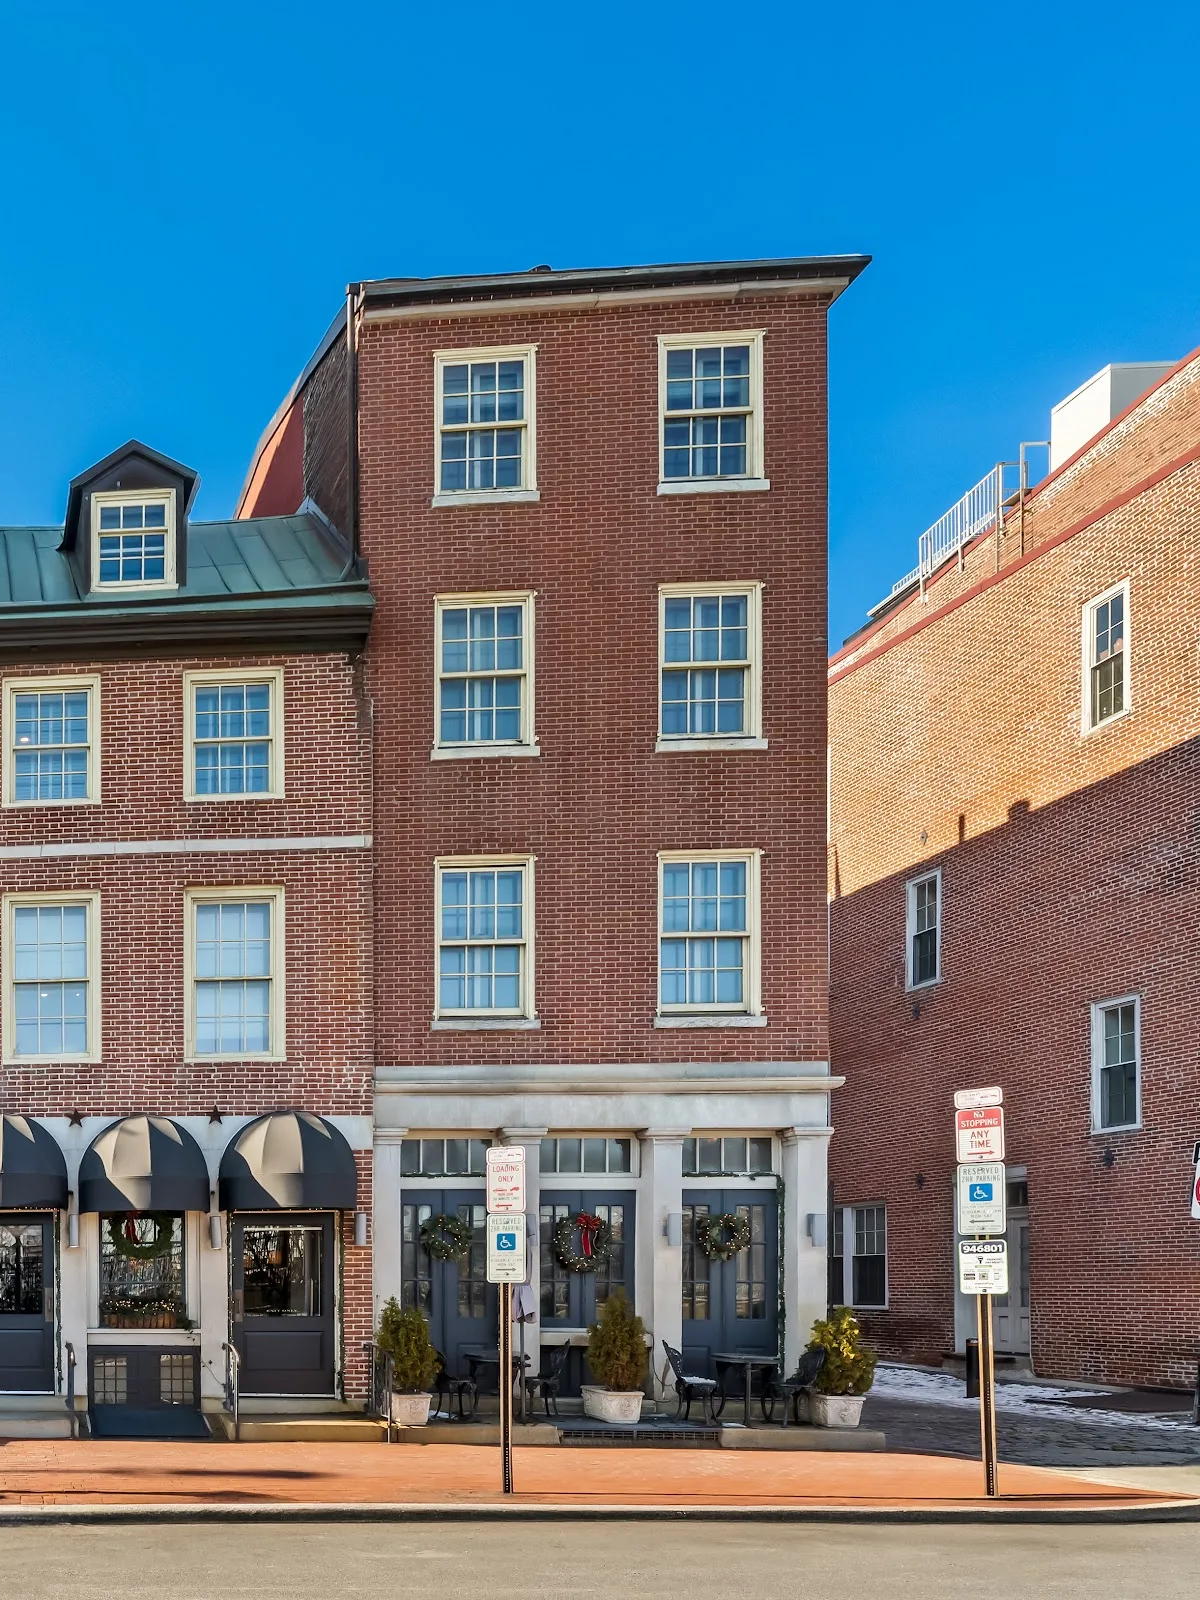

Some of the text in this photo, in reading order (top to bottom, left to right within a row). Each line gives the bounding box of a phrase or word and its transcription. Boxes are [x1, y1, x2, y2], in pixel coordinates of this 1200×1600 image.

[973, 1111, 985, 1119] NO
[960, 1117, 999, 1128] STOPPING
[970, 1130, 990, 1139] ANY
[969, 1139, 991, 1149] TIME
[963, 1167, 999, 1175] RESERVED
[497, 1175, 514, 1183] ONLY
[962, 1244, 1003, 1253] 946801
